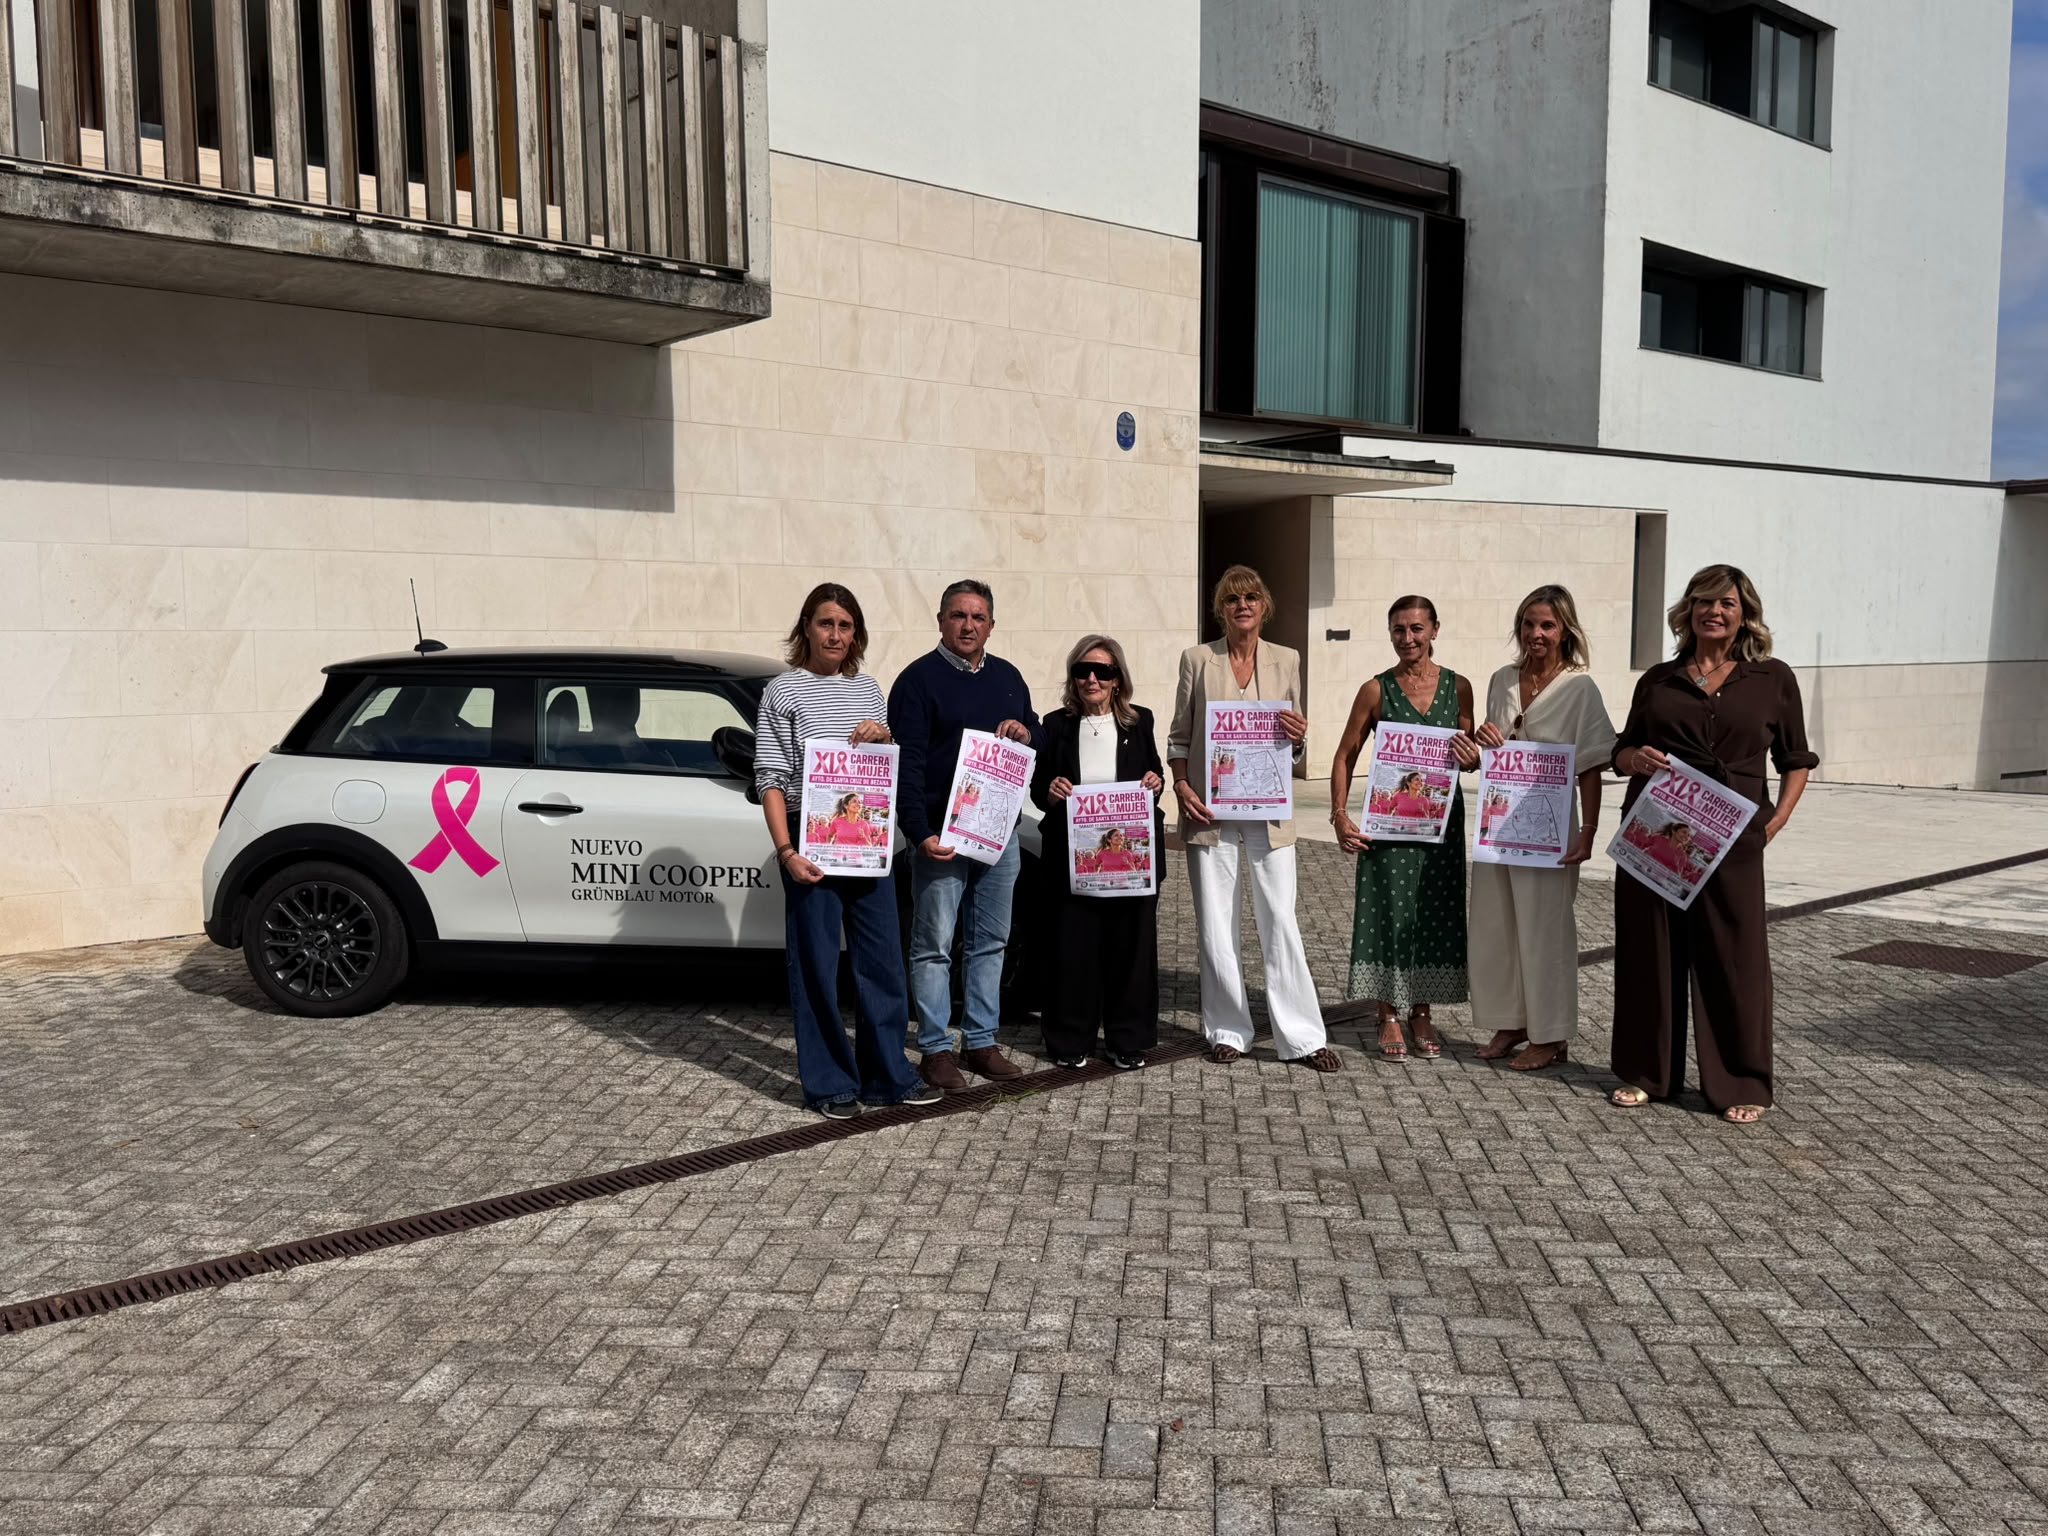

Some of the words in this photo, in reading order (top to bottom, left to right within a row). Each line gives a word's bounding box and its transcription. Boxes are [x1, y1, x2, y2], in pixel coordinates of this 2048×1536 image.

[1248, 712, 1280, 720] CARRER
[851, 754, 890, 766] CARRERA
[1001, 749, 1028, 767] CARRERA
[1422, 746, 1453, 760] MUJER
[1527, 753, 1566, 765] CARRERA
[857, 765, 889, 778] MUJER
[1003, 760, 1026, 777] MUJER
[1533, 764, 1566, 776] MUJER
[1110, 792, 1145, 803] CARRERA
[1116, 802, 1146, 813] MUJER
[1701, 790, 1742, 820] CARRERA
[1701, 804, 1737, 830] MUJER
[571, 839, 642, 856] NUEVO
[571, 862, 640, 884] MINI
[650, 864, 770, 888] COOPER.
[572, 887, 654, 902] GRÜNBLAU
[660, 890, 715, 904] MOTOR
